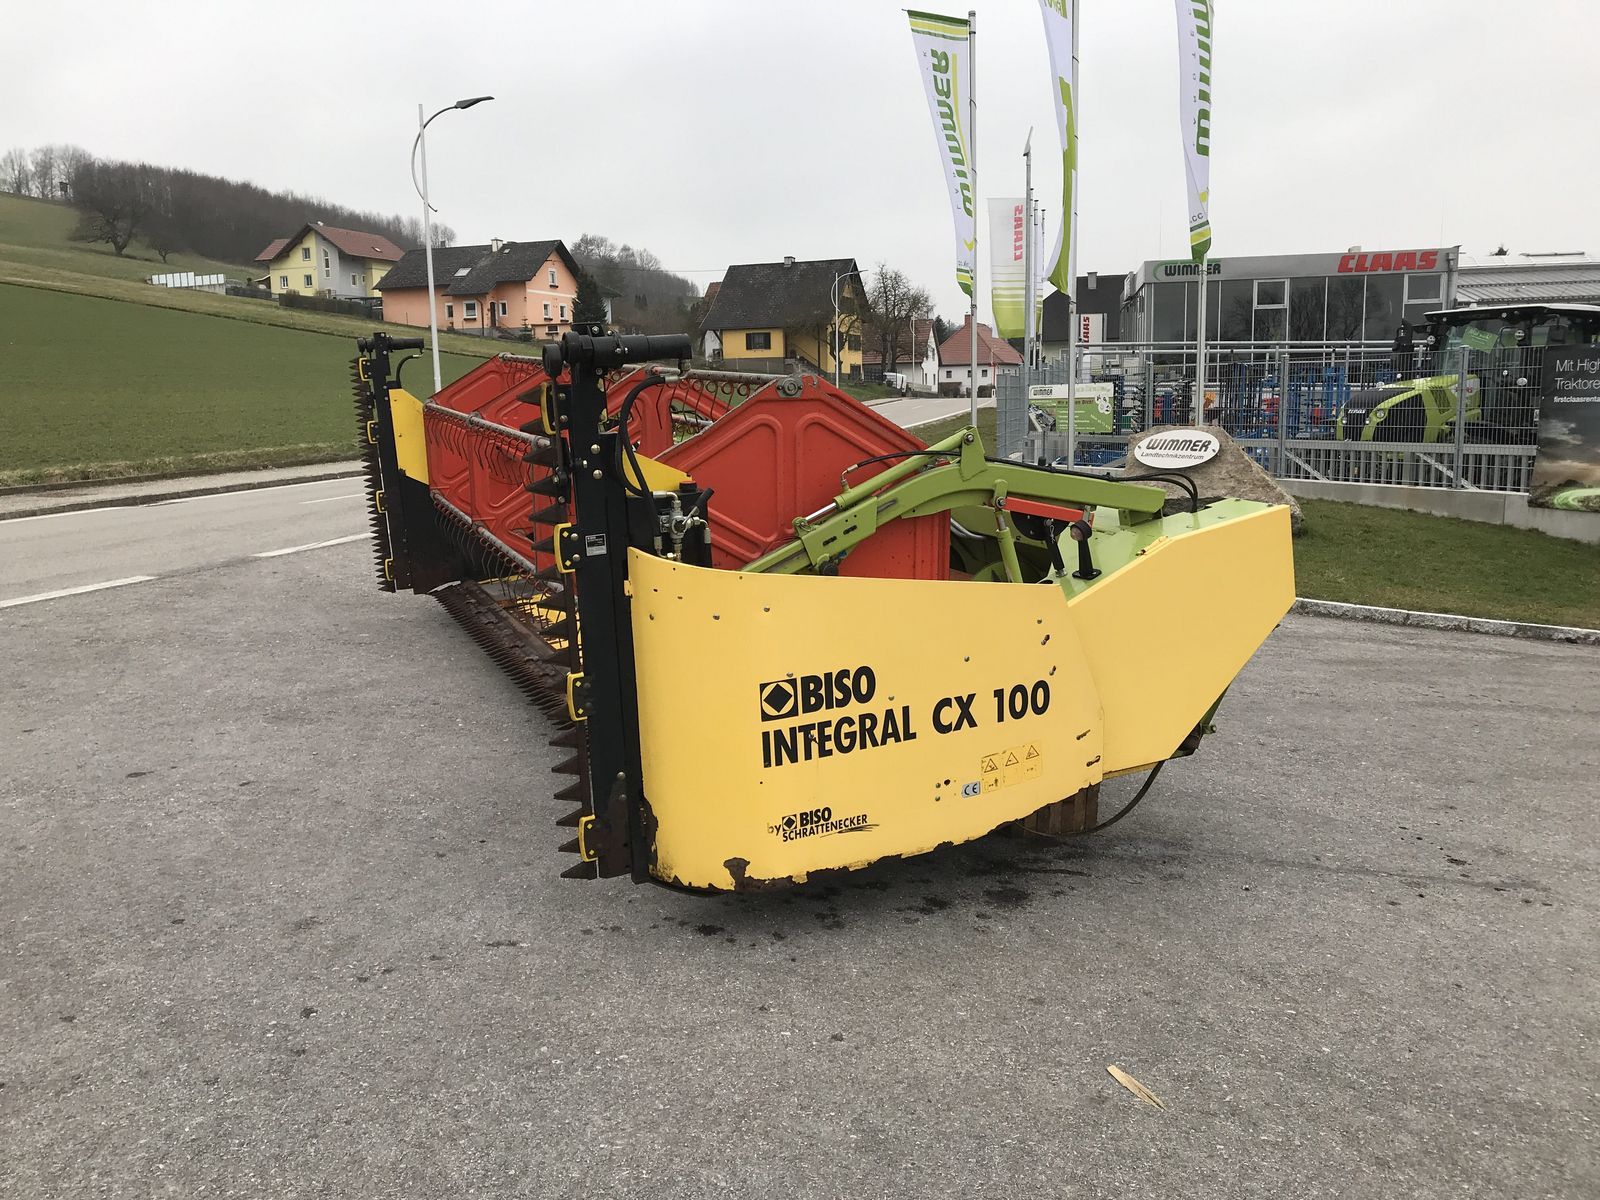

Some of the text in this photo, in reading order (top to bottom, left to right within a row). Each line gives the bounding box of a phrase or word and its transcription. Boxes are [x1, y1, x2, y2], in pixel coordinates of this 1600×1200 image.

[1337, 251, 1439, 273] CLAAS
[1556, 359, 1574, 371] Mit
[1141, 451, 1204, 460] Landtechnikzentrum
[1146, 439, 1212, 452] WIMMER
[801, 666, 876, 714] BISO
[762, 680, 1050, 769] INTEGRAL CX 100
[799, 806, 832, 827] BISO
[782, 814, 868, 842] SCHRATTENECKER
